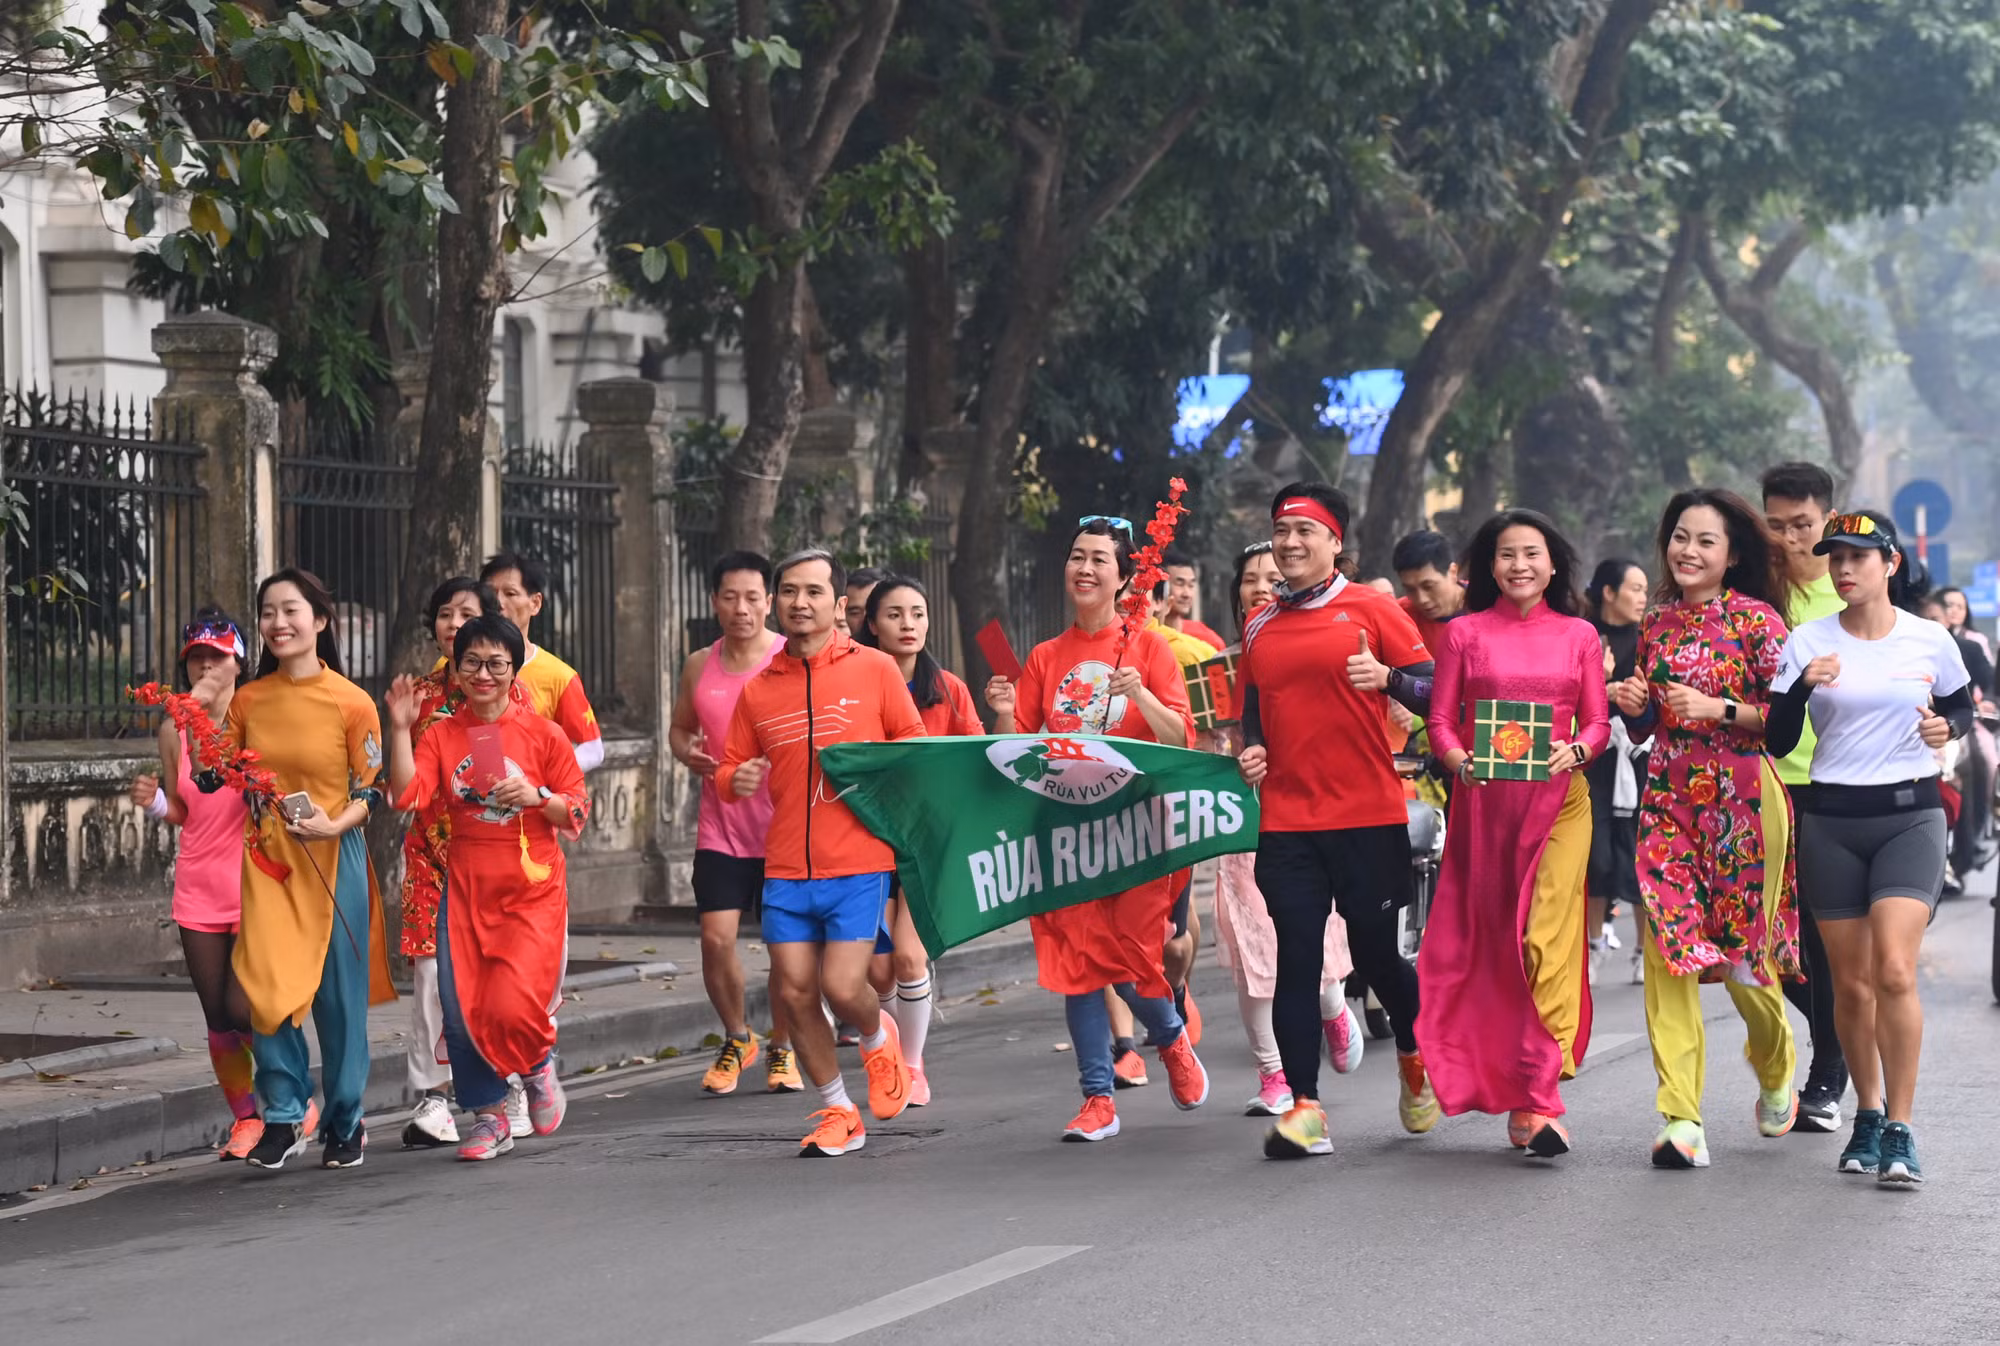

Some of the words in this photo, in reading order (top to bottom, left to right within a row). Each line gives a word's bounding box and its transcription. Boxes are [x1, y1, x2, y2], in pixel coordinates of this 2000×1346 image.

[1044, 780, 1075, 801] RÙA
[1078, 781, 1106, 800] VUI
[968, 830, 1043, 913] RÙA
[1051, 789, 1243, 887] RUNNERS
